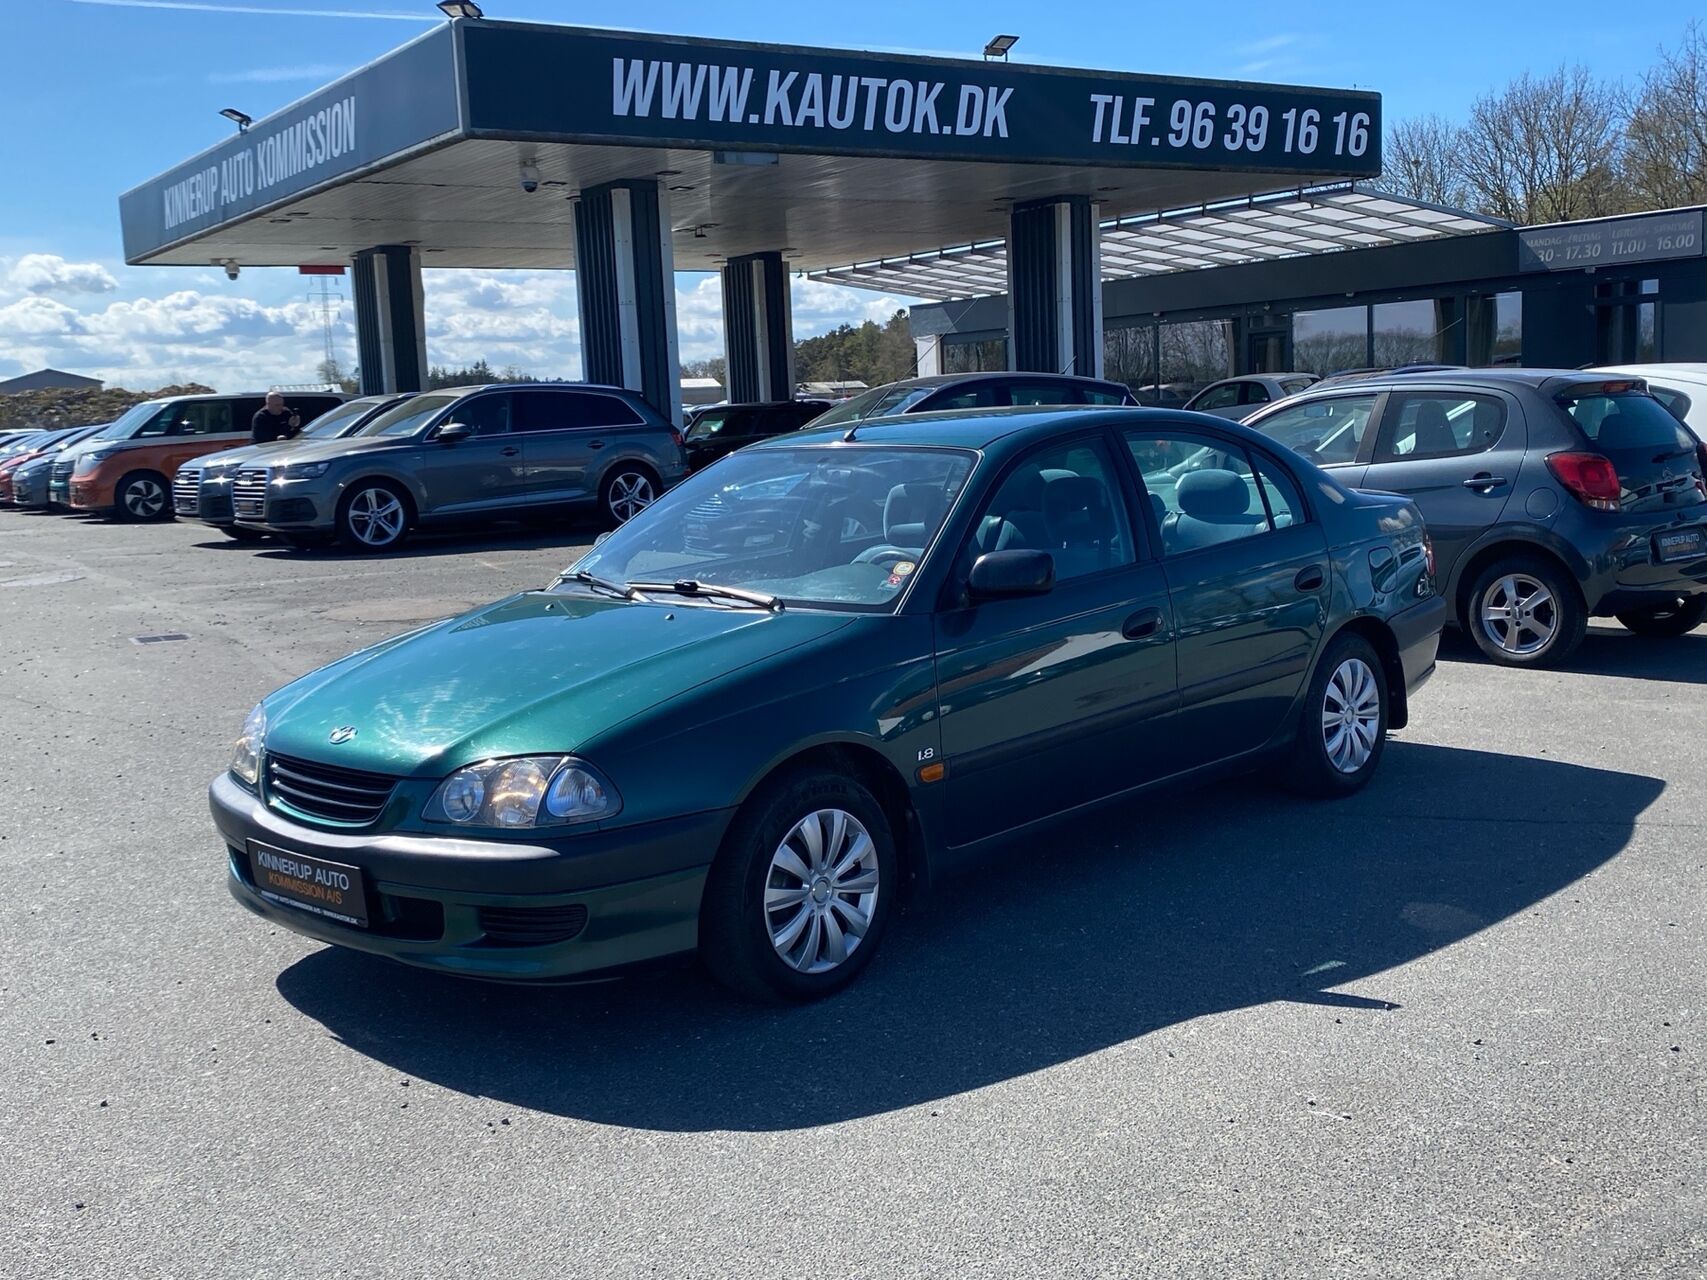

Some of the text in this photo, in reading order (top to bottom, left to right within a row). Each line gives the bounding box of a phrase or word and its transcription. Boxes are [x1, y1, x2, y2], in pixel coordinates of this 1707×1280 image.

[612, 57, 1014, 138] WWW.KAUTOK.DK
[1090, 93, 1370, 157] TLF. 96 39 16 16
[164, 96, 356, 230] KINNERUP AUTO KOMMISSION
[1566, 243, 1601, 260] 17.30
[1612, 239, 1647, 255] 11.00
[1657, 233, 1695, 251] 16.00
[257, 850, 349, 890] KINNERUP AUTO
[268, 871, 343, 905] KOMMISSION A/S
